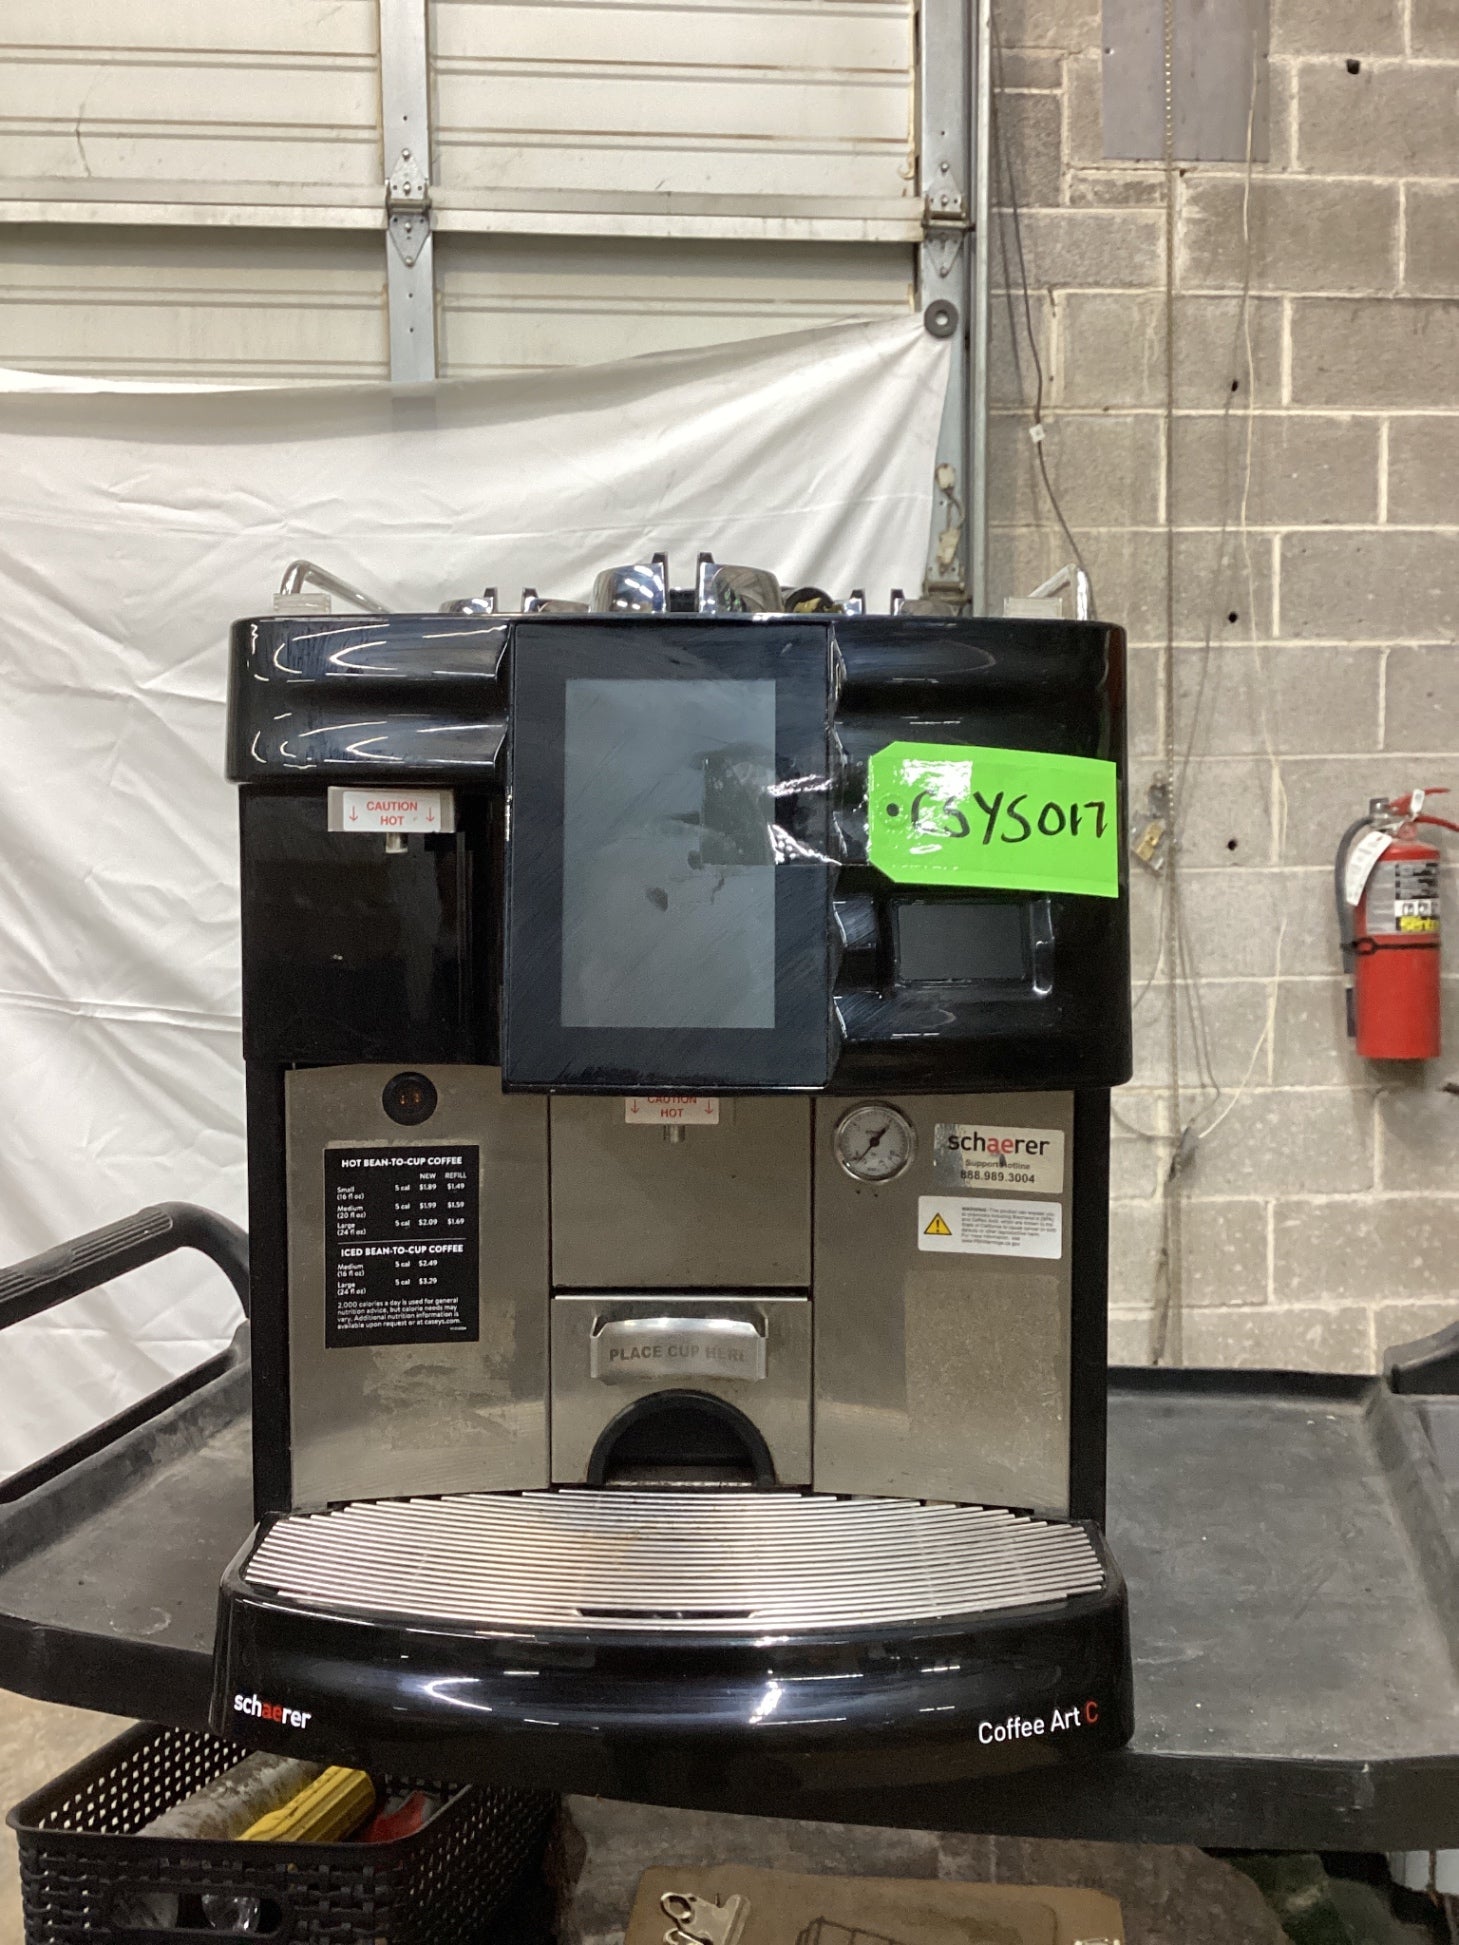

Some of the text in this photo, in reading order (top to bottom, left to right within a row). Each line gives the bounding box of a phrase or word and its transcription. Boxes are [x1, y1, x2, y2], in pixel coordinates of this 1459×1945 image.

[366, 801, 418, 812] CAUTION
[380, 816, 404, 826] HOT
[647, 1096, 697, 1104] CAUTION
[660, 1108, 683, 1118] HOT
[948, 1131, 1050, 1155] schaerer
[341, 1156, 463, 1168] HOT BEAN-TO-CUP COFFEE
[965, 1159, 1000, 1169] Support
[419, 1171, 467, 1180] NEW REFILL
[960, 1170, 1035, 1183] 888.989.3004
[337, 1186, 355, 1194] Small
[394, 1184, 400, 1192] 5
[337, 1205, 364, 1213] Medium
[394, 1202, 400, 1211] 5
[337, 1222, 356, 1231] Large
[394, 1219, 400, 1227] 5
[400, 1219, 411, 1227] cal
[341, 1244, 464, 1257] ICED BEAN-TO-CUP COFFEE
[337, 1263, 364, 1271] Medium
[337, 1281, 356, 1289] Large
[609, 1346, 662, 1361] PLACE
[667, 1345, 700, 1358] CUP
[233, 1693, 312, 1729] schaerer
[978, 1700, 1099, 1745] Coffee Art C
